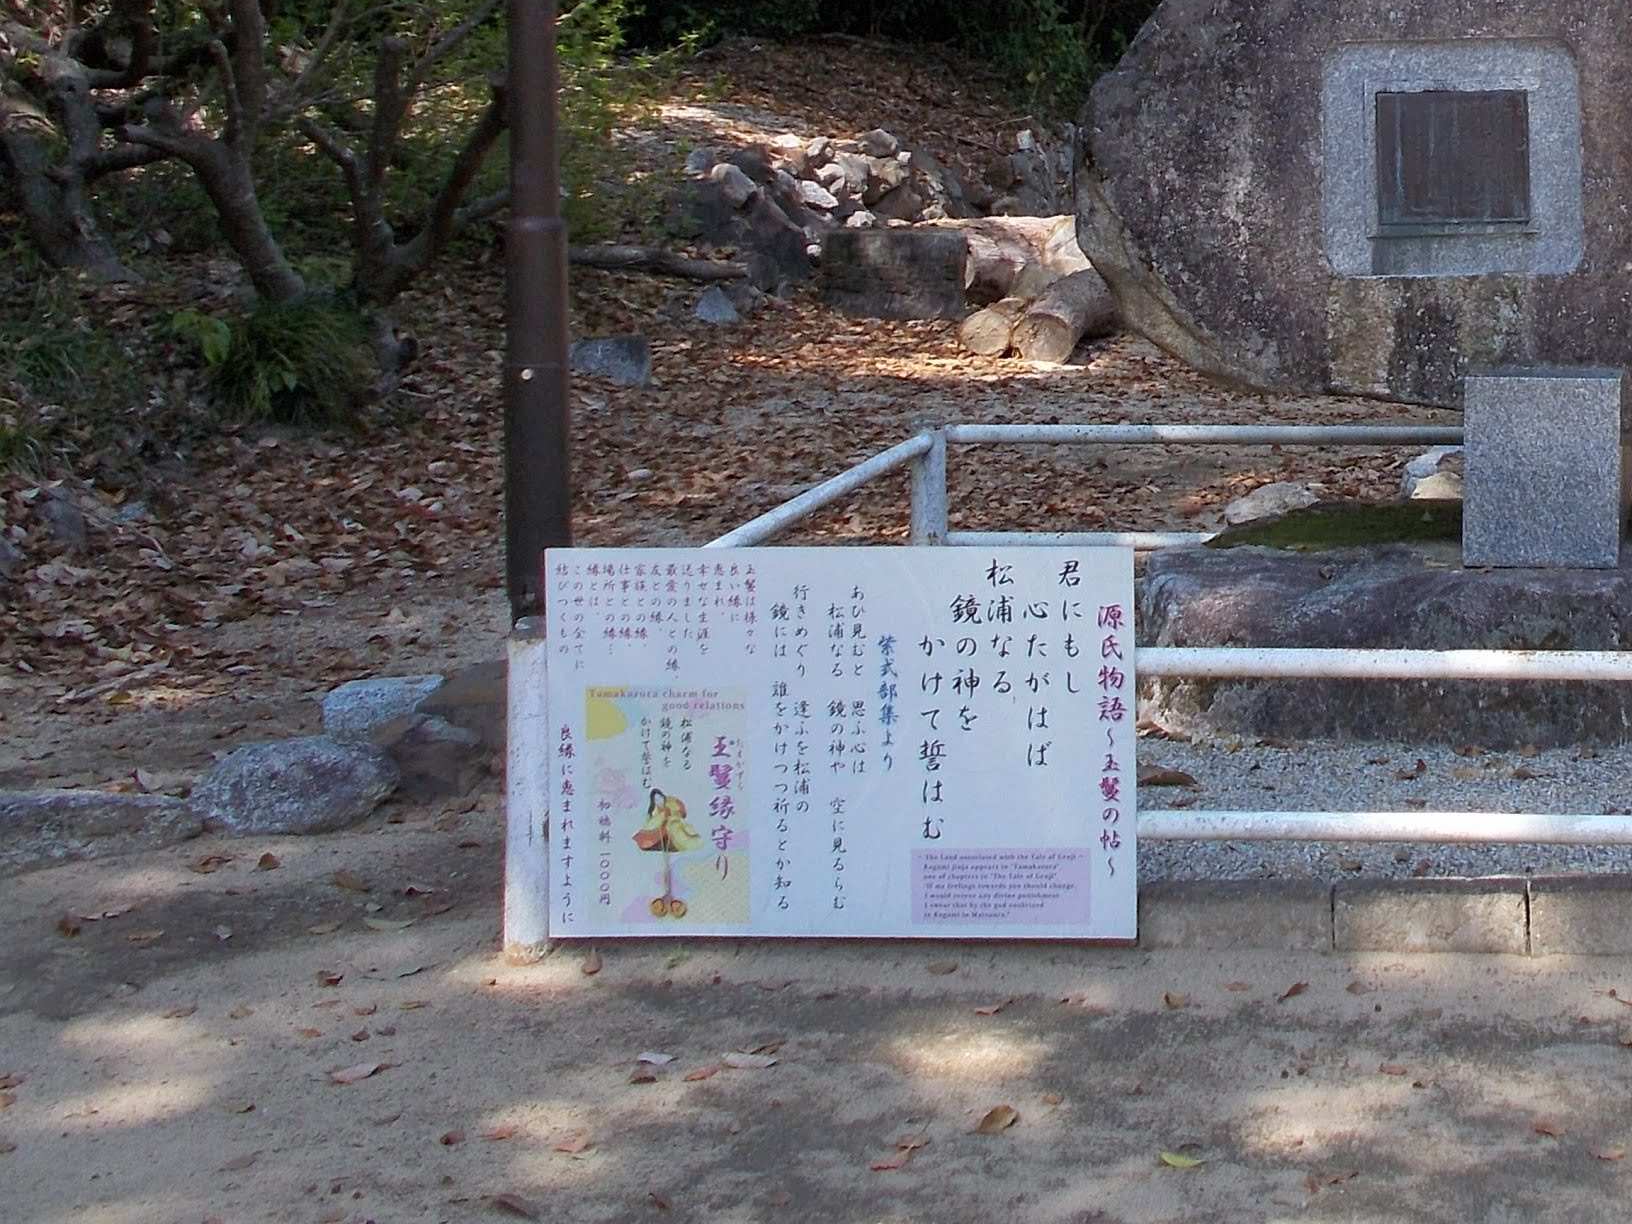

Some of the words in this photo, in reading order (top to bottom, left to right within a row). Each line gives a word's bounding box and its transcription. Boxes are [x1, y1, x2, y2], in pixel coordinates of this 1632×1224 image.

[556, 564, 569, 655] 結びつくもの
[697, 564, 710, 655] 幸せな生涯を
[728, 564, 743, 623] 良い縁に
[769, 602, 789, 657] 鏡には
[793, 585, 810, 677] 行きめぐり
[827, 601, 845, 678] 松浦なる
[851, 585, 867, 677] あひ見むと
[986, 559, 1015, 694] 松浦なる
[1058, 560, 1083, 695] 君にもし
[662, 688, 698, 698] charm
[702, 688, 718, 698] for
[662, 701, 689, 711] good
[694, 700, 745, 710] relations
[877, 635, 899, 770] 紫式部集より
[949, 594, 982, 732] 鏡の神を
[1023, 600, 1051, 767] 心たがはば
[680, 717, 693, 770] 松浦なる
[793, 698, 811, 813] 逢ふを松浦の
[828, 697, 847, 773] 鏡の神や
[850, 697, 867, 774] 思ふ心は
[918, 635, 947, 839] かけて誓はむ
[558, 725, 576, 923] 良縁に恵まれますように
[772, 680, 791, 911] 誰をかけつつ祈るとか知る
[830, 797, 847, 909] 空に見るらむ
